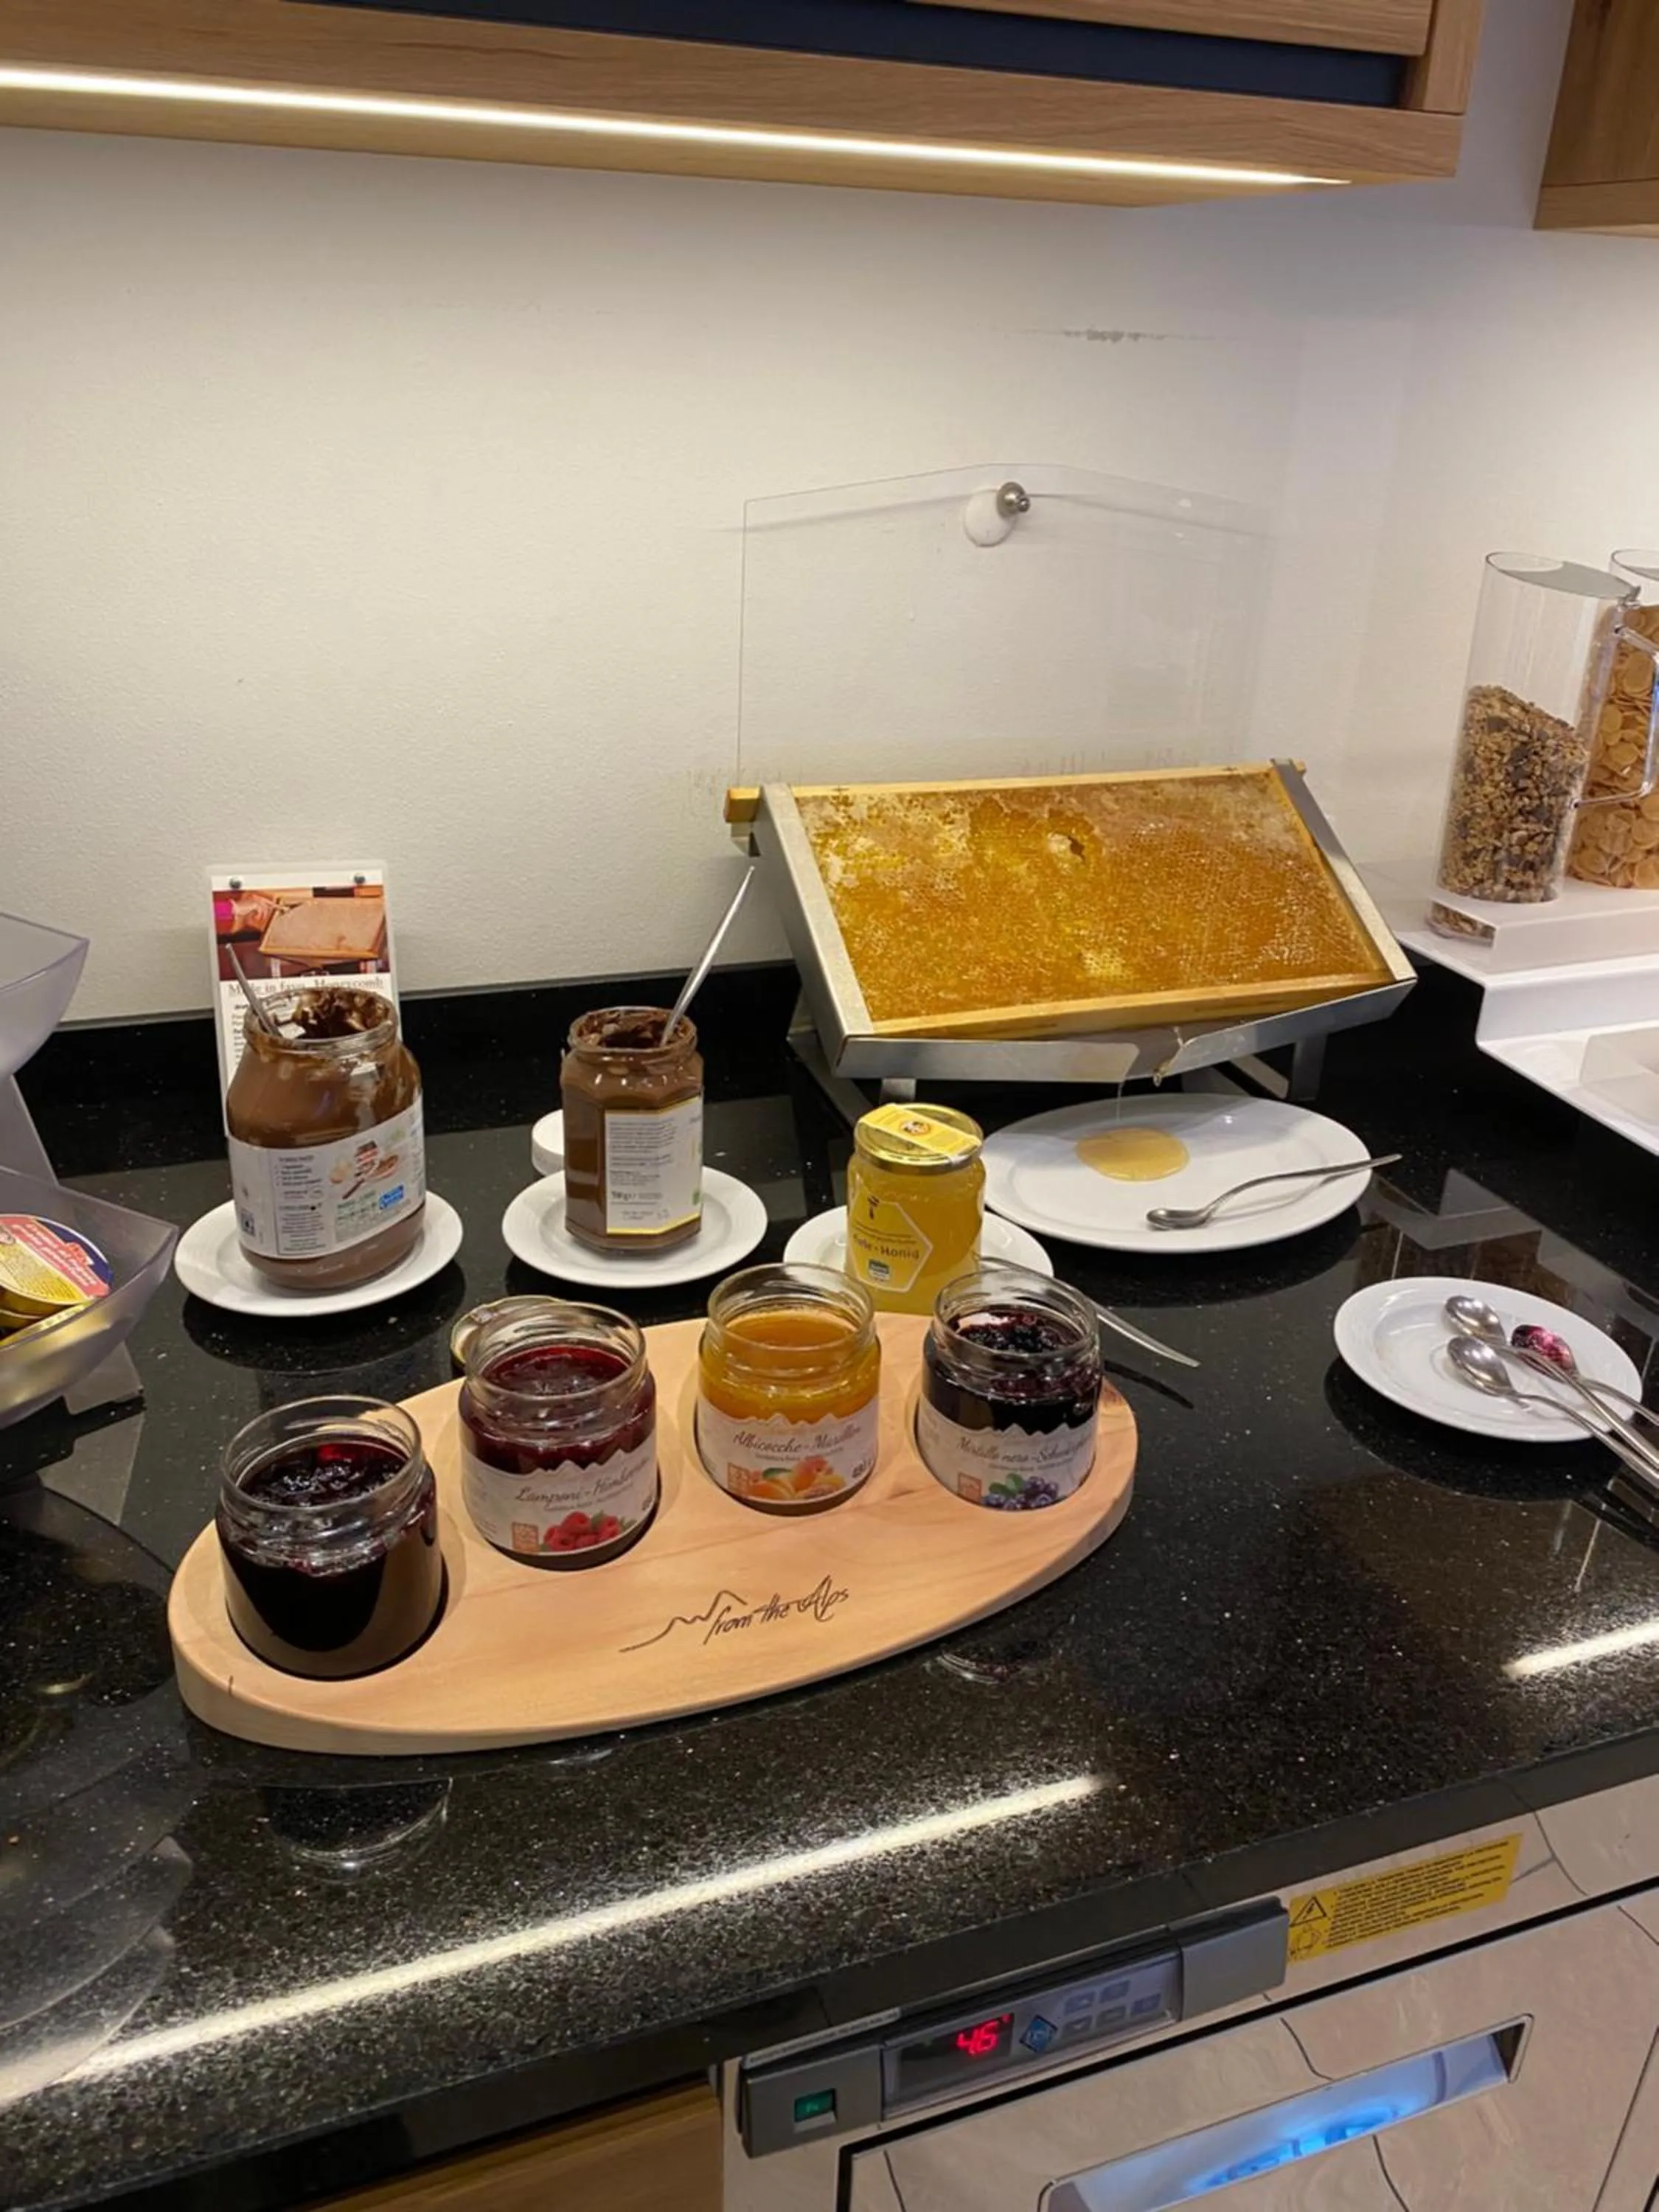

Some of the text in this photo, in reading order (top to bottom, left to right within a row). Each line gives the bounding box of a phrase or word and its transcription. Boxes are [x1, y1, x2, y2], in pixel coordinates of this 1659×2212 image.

[702, 1574, 849, 1646] from the Alps
